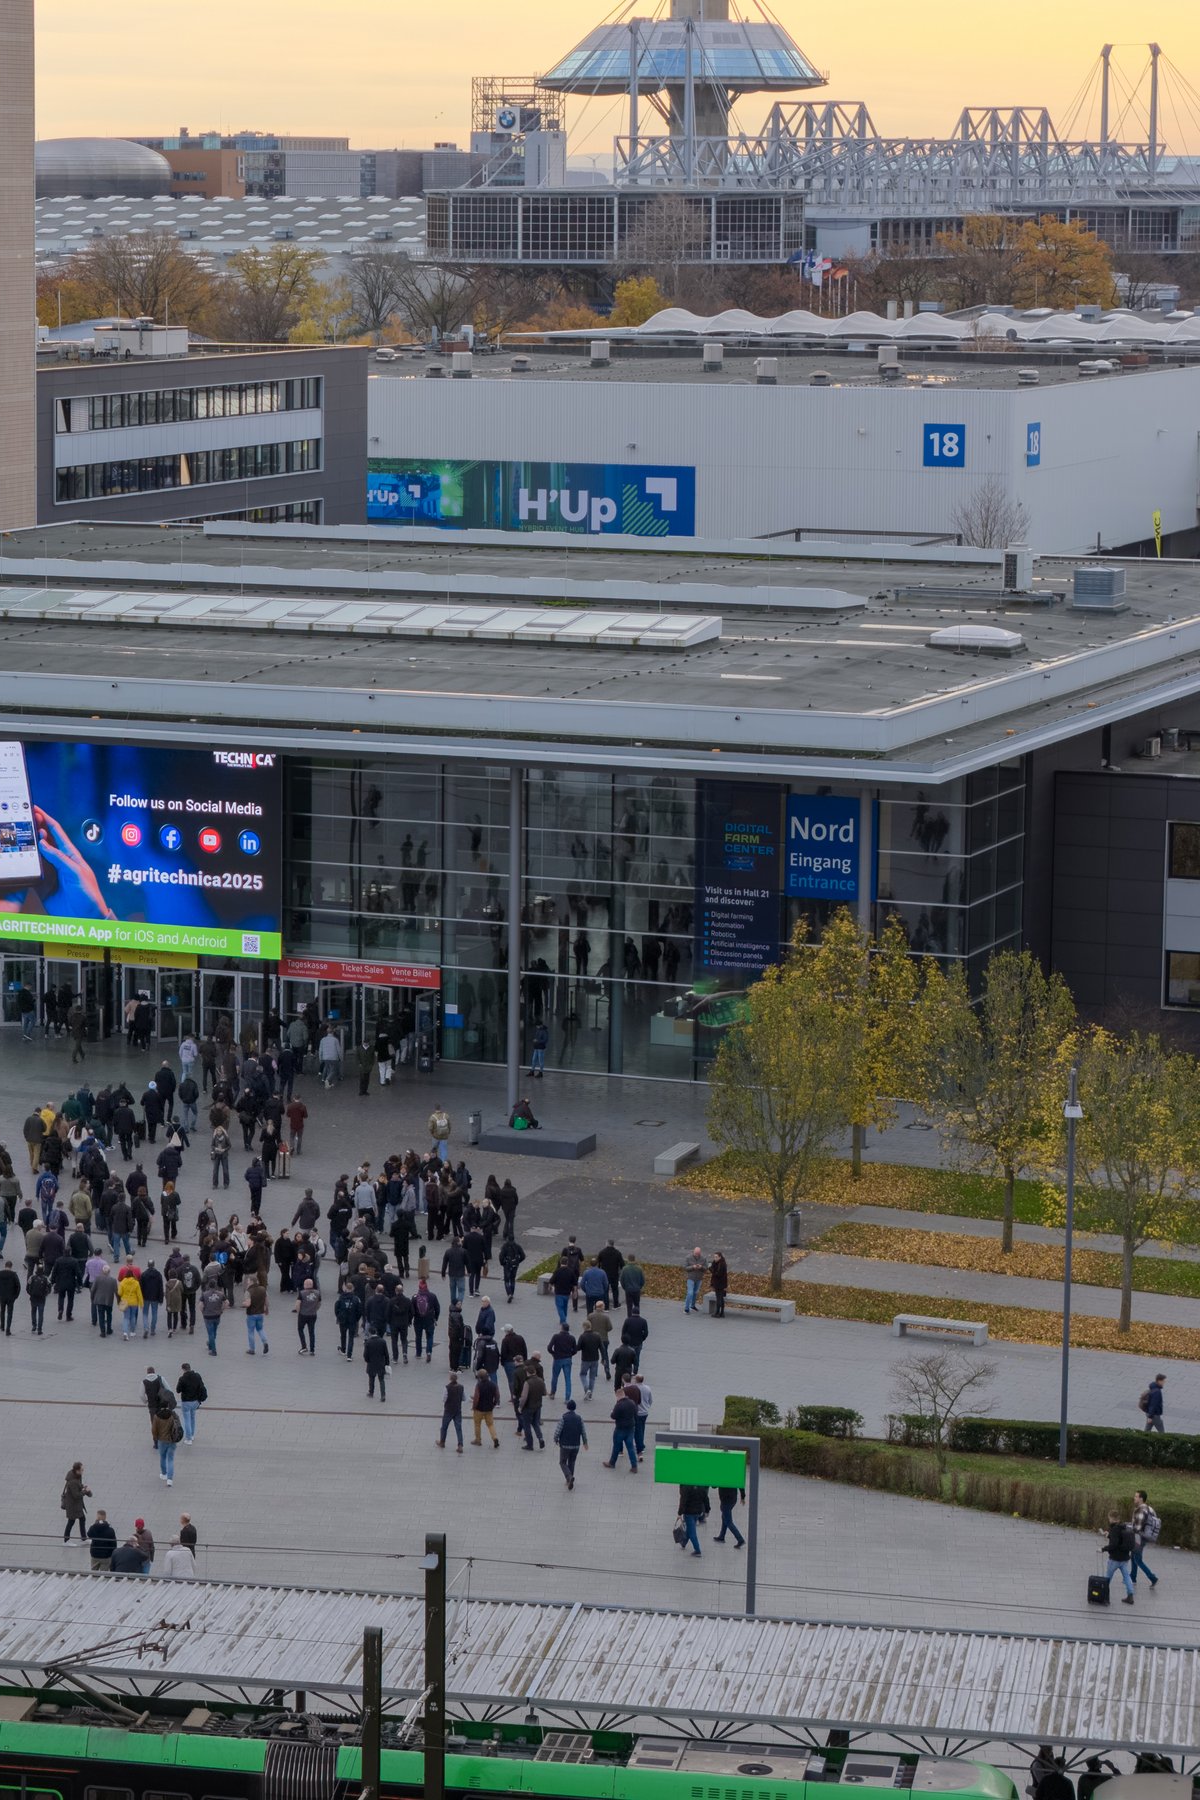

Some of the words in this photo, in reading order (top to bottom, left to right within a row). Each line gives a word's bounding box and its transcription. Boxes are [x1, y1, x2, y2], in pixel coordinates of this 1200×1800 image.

[929, 432, 959, 457] 18
[1029, 431, 1040, 456] 18
[519, 488, 617, 531] H'Up
[109, 794, 147, 808] Follow
[151, 799, 164, 809] us
[168, 801, 183, 811] on
[186, 799, 222, 813] Social
[225, 802, 263, 815] Media
[725, 823, 772, 835] DIGITAL
[790, 816, 854, 843] Nord
[725, 833, 760, 844] FARM
[724, 844, 774, 855] CENTER
[790, 853, 851, 874] Eingang
[108, 864, 263, 890] #agritechnica2025
[789, 873, 855, 891] Entrance
[705, 886, 722, 895] Visit
[734, 888, 742, 897] in
[743, 889, 759, 898] Hall
[761, 890, 769, 898] 21
[704, 896, 719, 904] and
[720, 896, 755, 906] discover:
[711, 911, 730, 919] Digital
[731, 912, 753, 921] farming
[711, 921, 744, 929] Automation
[89, 926, 112, 941] App
[115, 928, 131, 940] for
[135, 929, 154, 943] iOS
[157, 932, 179, 945] and
[182, 934, 227, 948] Android
[711, 930, 736, 938] Robotics
[711, 940, 735, 948] Artificial
[736, 942, 770, 951] intelligence
[67, 949, 90, 959] Presse
[711, 949, 742, 957] Discussion
[743, 951, 763, 960] panels
[287, 960, 328, 970] Tageskasse
[341, 964, 363, 973] Ticket
[364, 966, 384, 975] Sales
[390, 968, 411, 976] Vente
[413, 969, 432, 978] Billet
